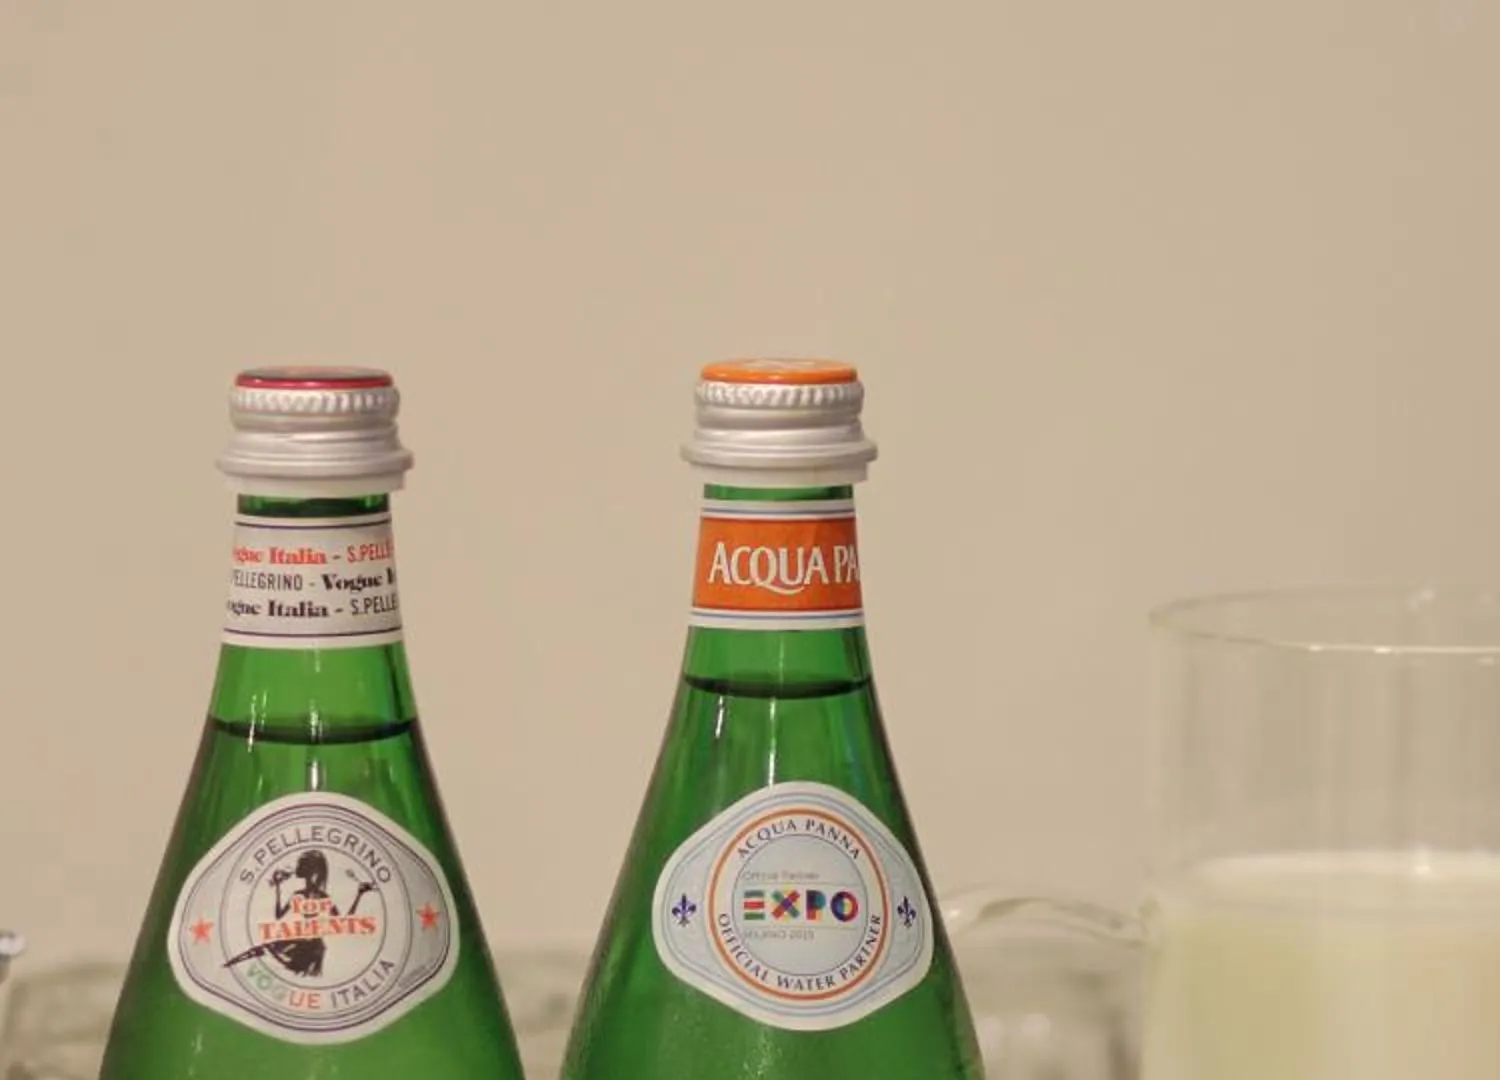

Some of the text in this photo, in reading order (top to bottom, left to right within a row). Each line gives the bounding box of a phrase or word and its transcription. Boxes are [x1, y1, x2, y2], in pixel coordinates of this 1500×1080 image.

[269, 546, 328, 564] Italia
[707, 541, 829, 595] ACQUA
[321, 572, 383, 592] Vogue
[268, 599, 330, 617] Italia
[239, 825, 393, 885] S.PELLEGRINO
[738, 818, 862, 860] ACQUA PANNA
[743, 888, 860, 922] EXPO
[259, 916, 377, 940] TALENTS
[718, 912, 882, 991] OFFICIAL WATER PARTNER
[246, 958, 395, 1009] VOGUE ITALIA
